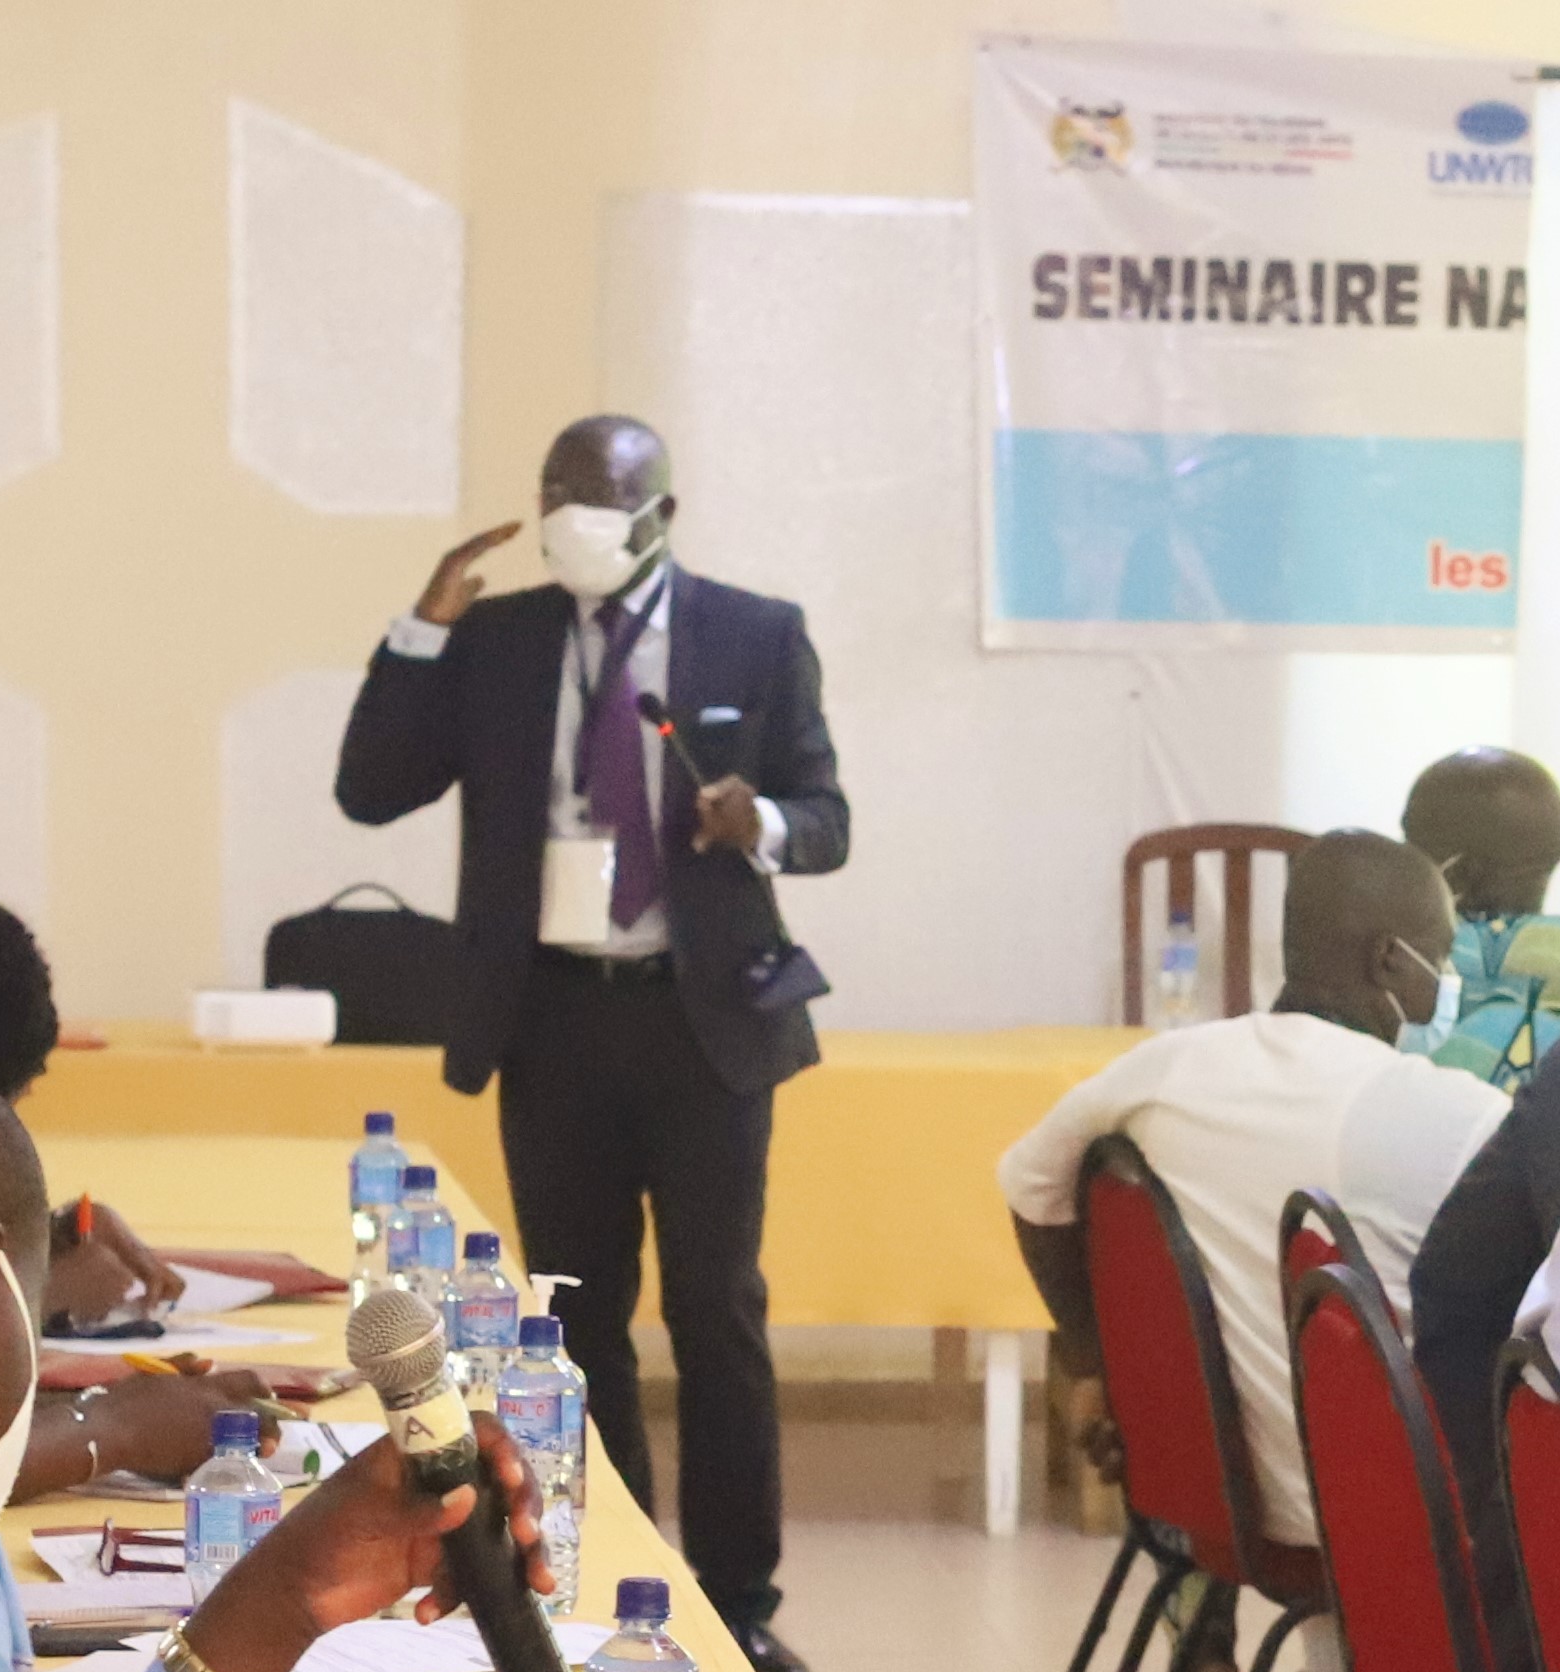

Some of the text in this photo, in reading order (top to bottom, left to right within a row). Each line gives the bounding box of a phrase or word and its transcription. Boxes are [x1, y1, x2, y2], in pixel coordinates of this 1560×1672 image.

[1427, 151, 1533, 184] UNWT
[1032, 253, 1420, 328] SEMINAIRE
[1431, 542, 1507, 588] les
[404, 1415, 436, 1446] A
